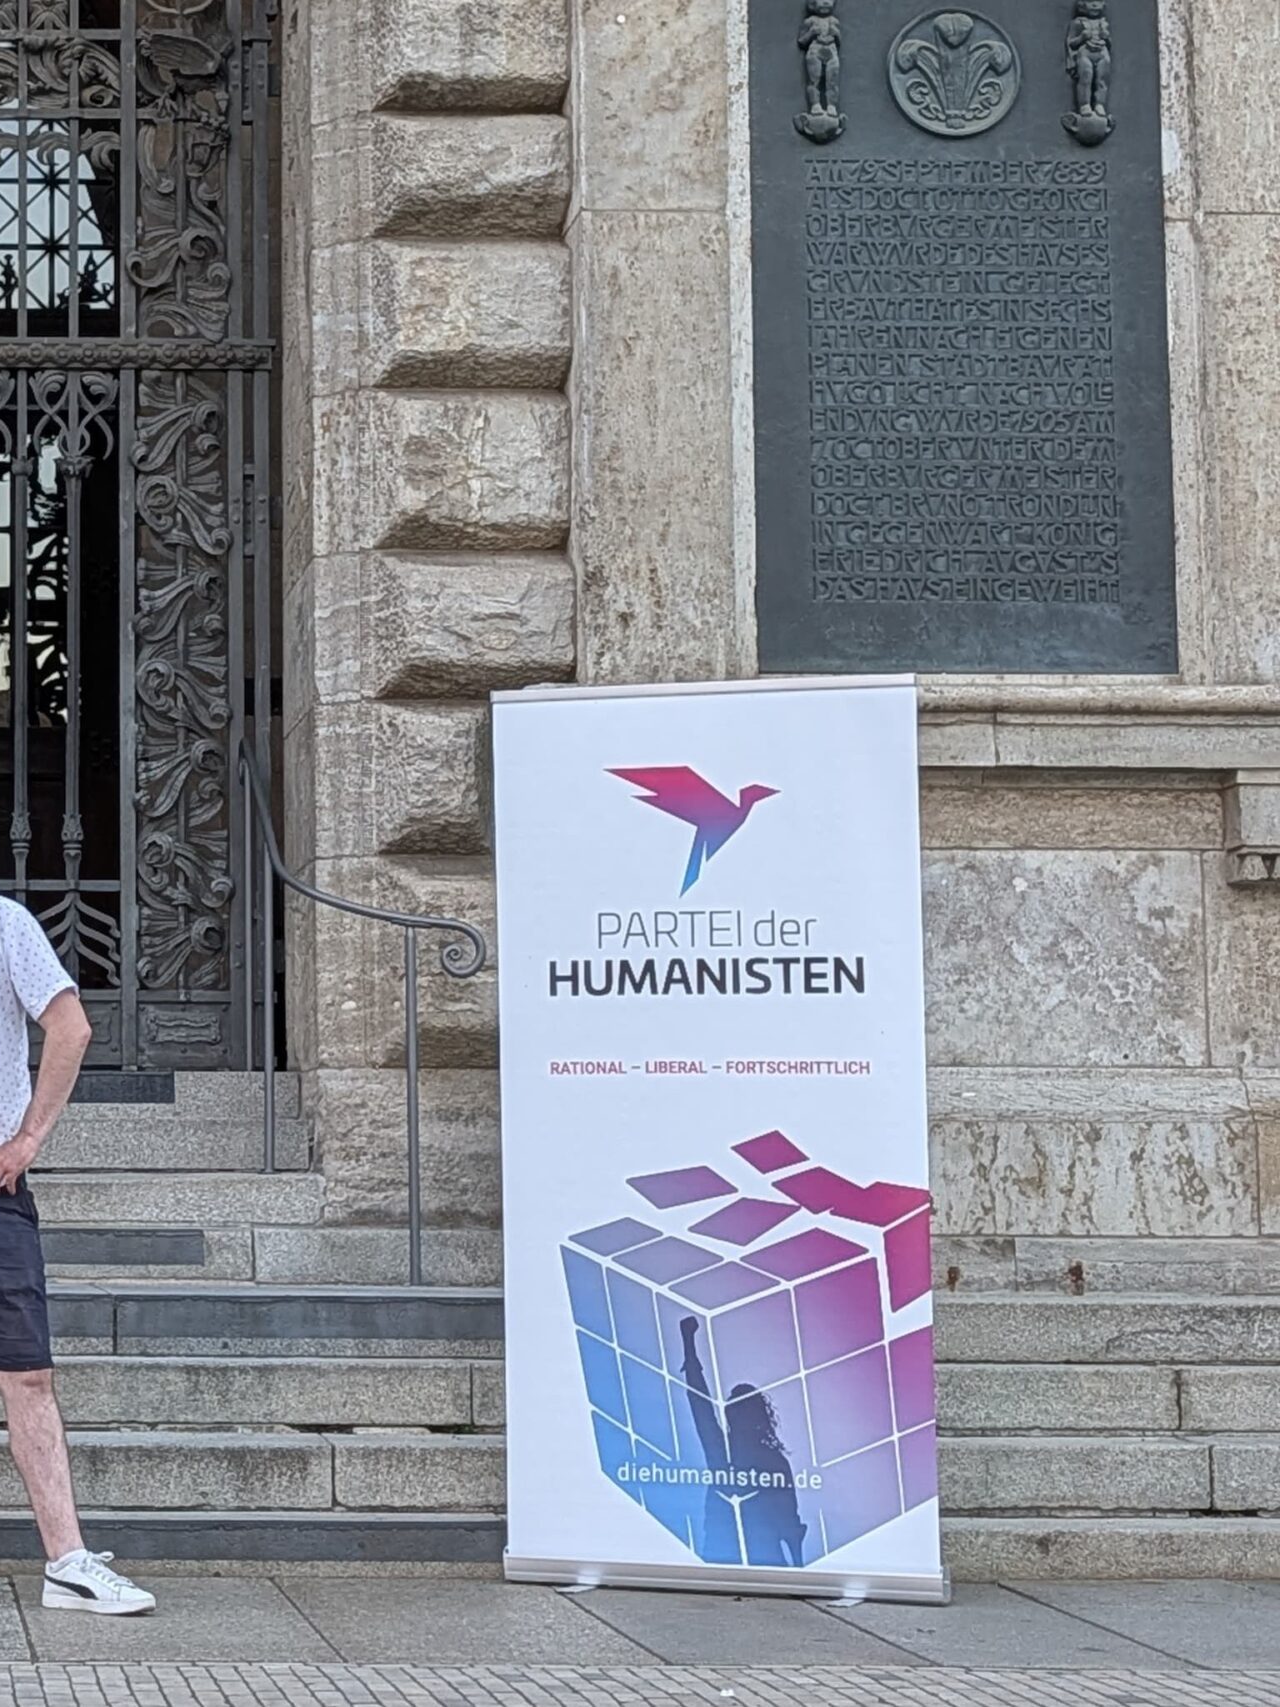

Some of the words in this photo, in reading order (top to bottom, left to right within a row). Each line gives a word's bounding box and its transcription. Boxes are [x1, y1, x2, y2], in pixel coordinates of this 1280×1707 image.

[881, 161, 1039, 185] SEPTEMBER
[596, 909, 743, 949] PARTEI
[752, 909, 819, 948] der
[548, 956, 866, 997] HUMANISTEN
[549, 1060, 627, 1075] RATIONAL
[644, 1060, 708, 1075] LIBERAL
[725, 1060, 871, 1075] FORTSCHRITTLICH
[617, 1462, 823, 1490] diehumanisten.de
